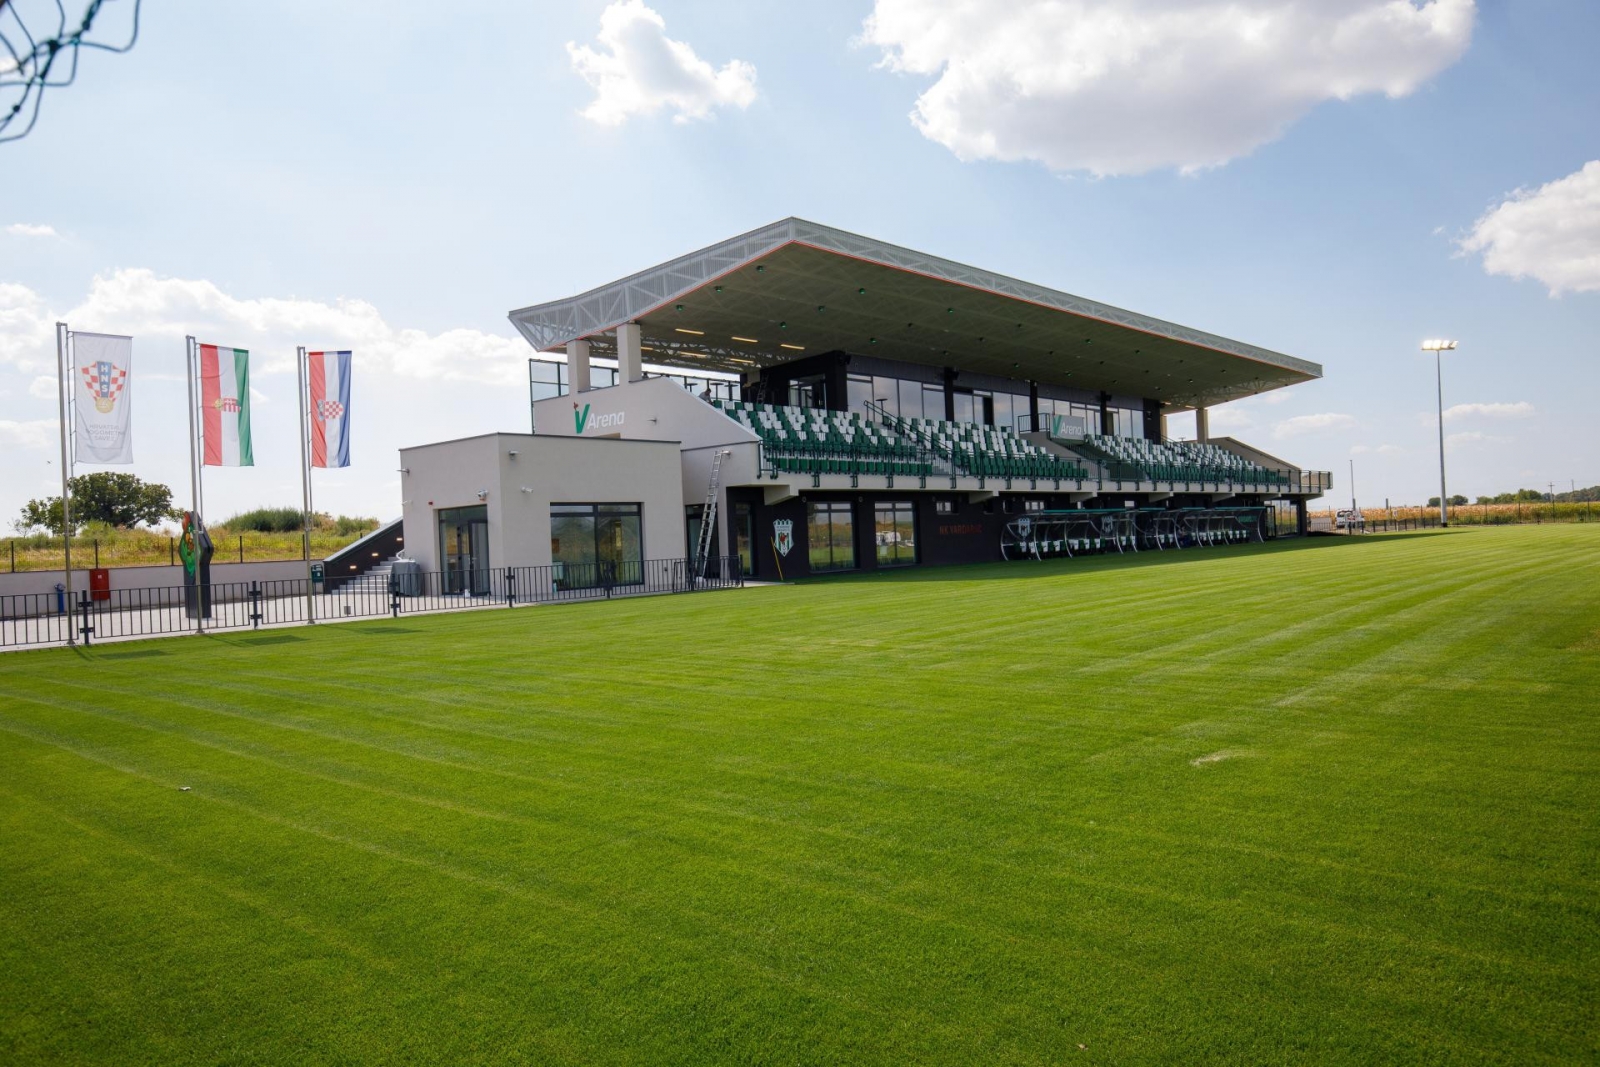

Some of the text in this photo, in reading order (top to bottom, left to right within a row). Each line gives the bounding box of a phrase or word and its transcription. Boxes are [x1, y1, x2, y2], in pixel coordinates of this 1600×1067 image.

[100, 365, 109, 392] HNS
[575, 403, 625, 434] V Arena
[1053, 415, 1082, 436] V Arena
